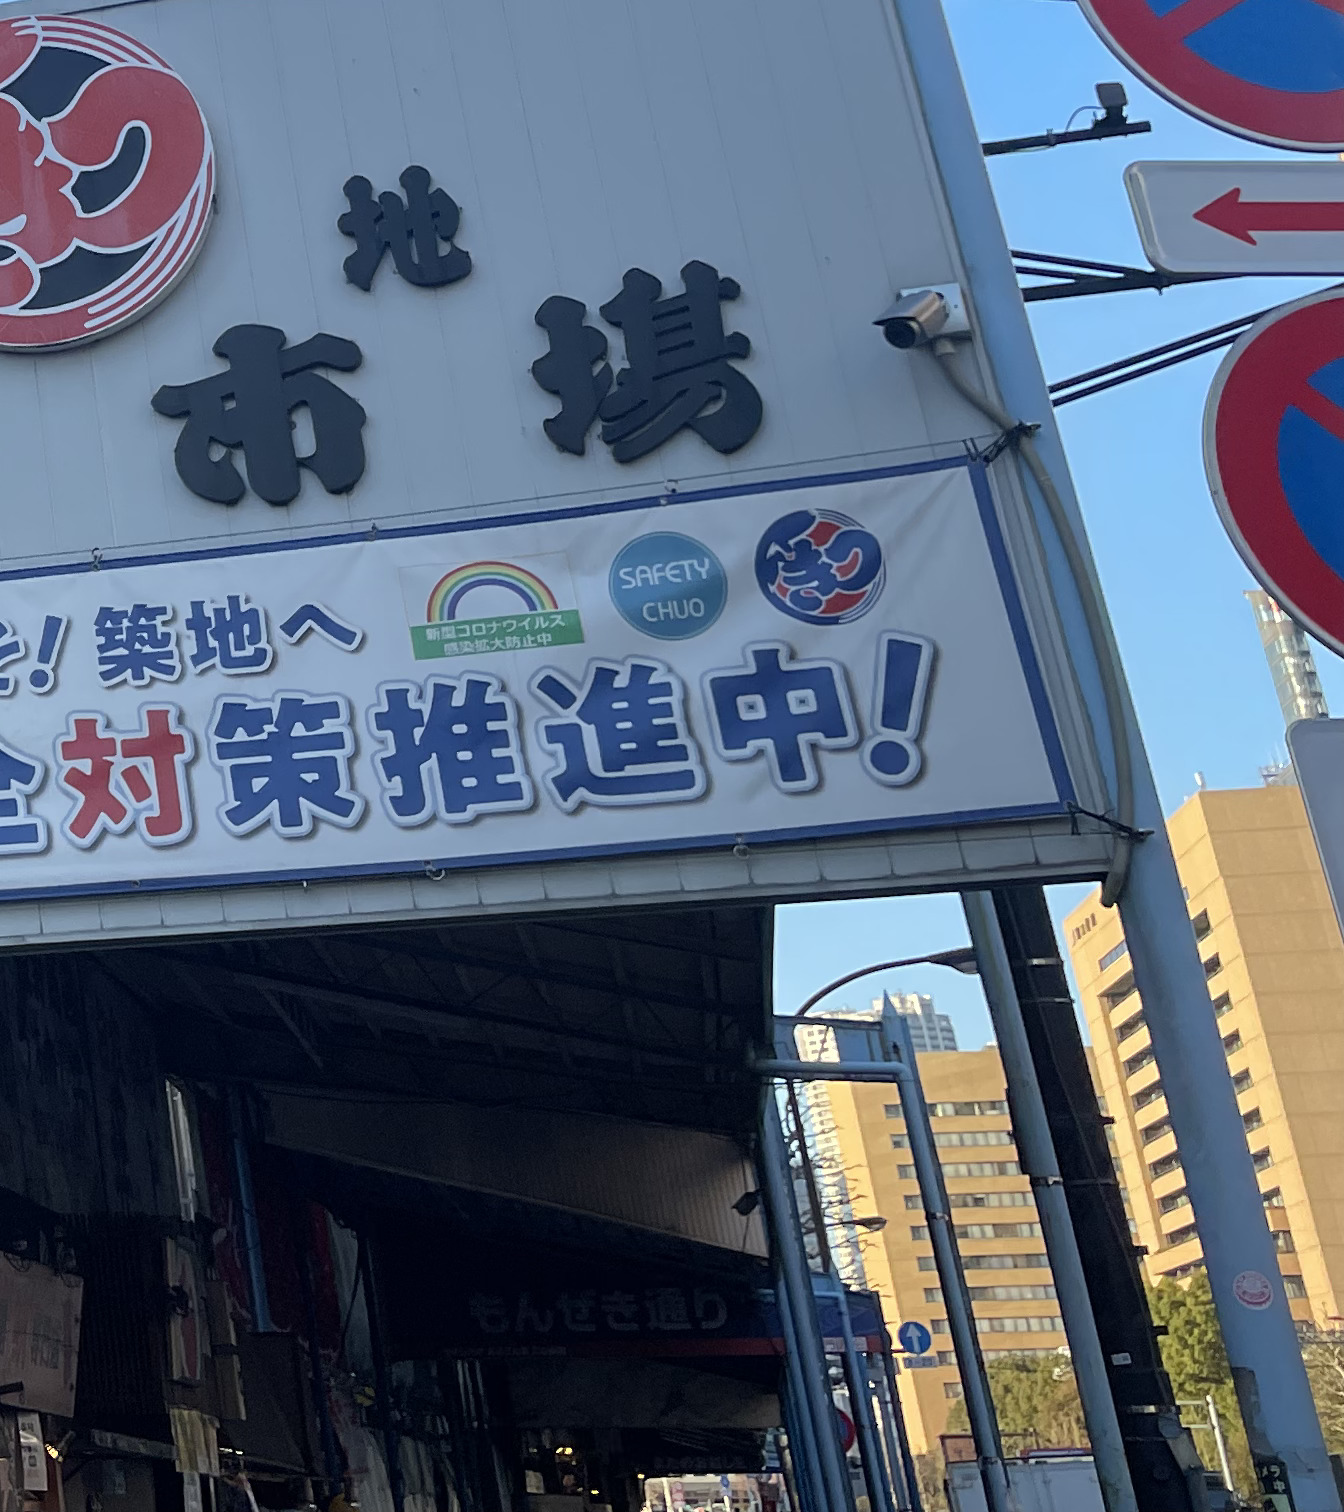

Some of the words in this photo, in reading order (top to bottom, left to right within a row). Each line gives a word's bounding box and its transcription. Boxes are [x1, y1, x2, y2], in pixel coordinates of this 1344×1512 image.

[618, 558, 711, 590] SAFETY
[641, 597, 706, 623] CHUO
[425, 614, 567, 642] 新型コロナウイルス
[443, 632, 553, 656] 感染拡大防止中
[467, 1286, 728, 1334] もんぜき通り
